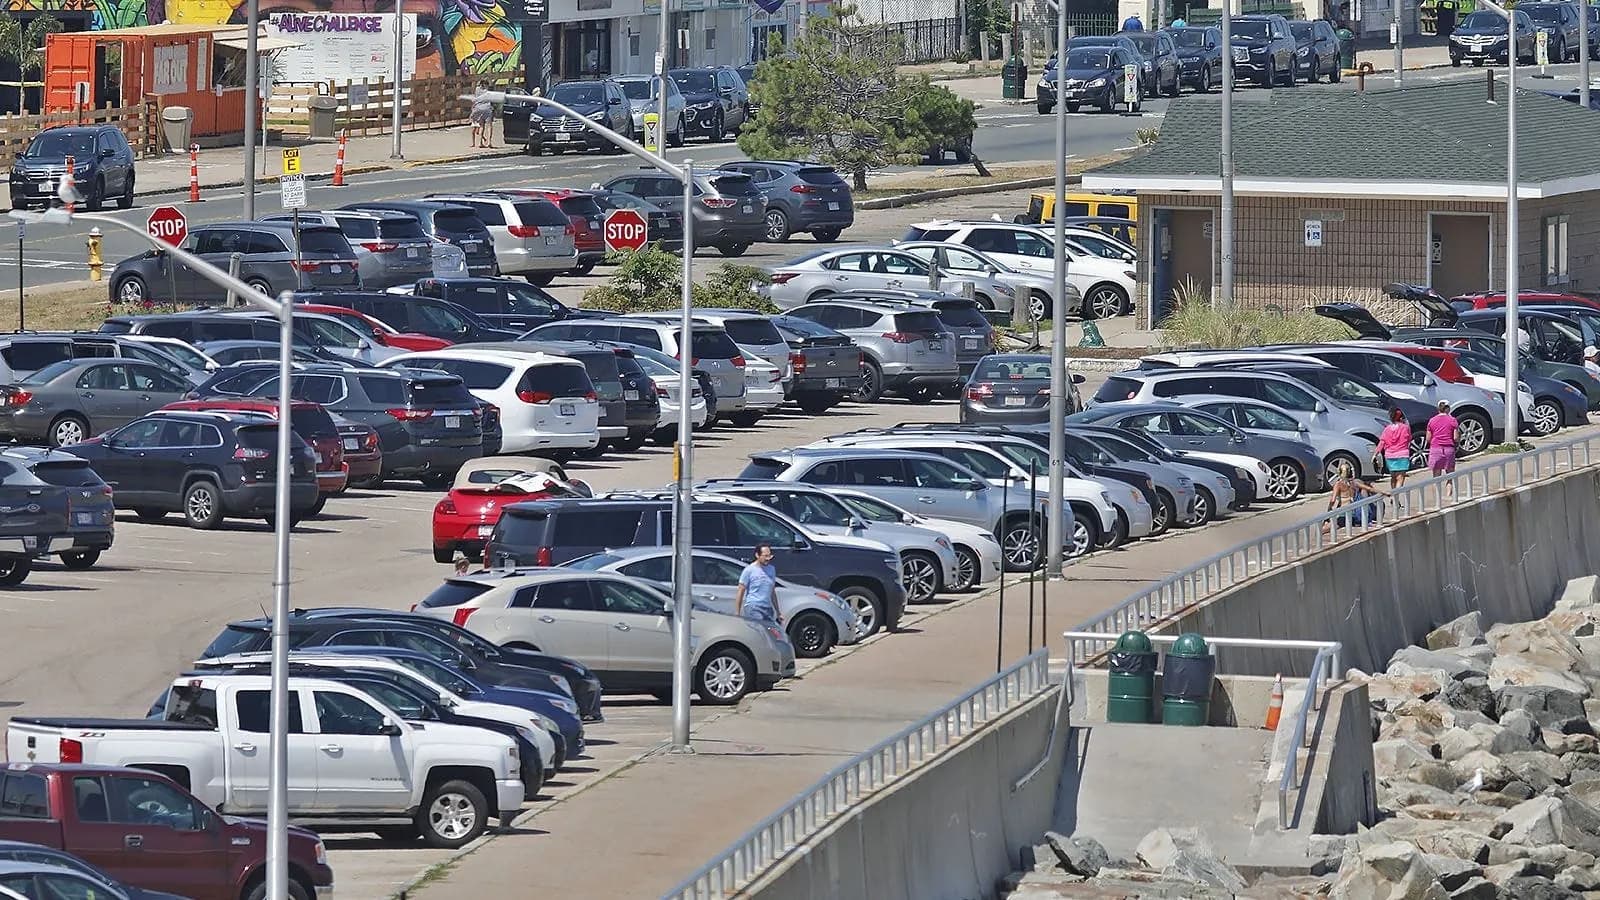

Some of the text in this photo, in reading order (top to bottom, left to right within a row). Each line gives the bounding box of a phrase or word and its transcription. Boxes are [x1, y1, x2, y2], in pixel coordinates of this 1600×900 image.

[284, 150, 298, 158] LOT
[288, 159, 296, 170] E
[150, 219, 184, 237] STOP
[608, 223, 644, 240] STOP
